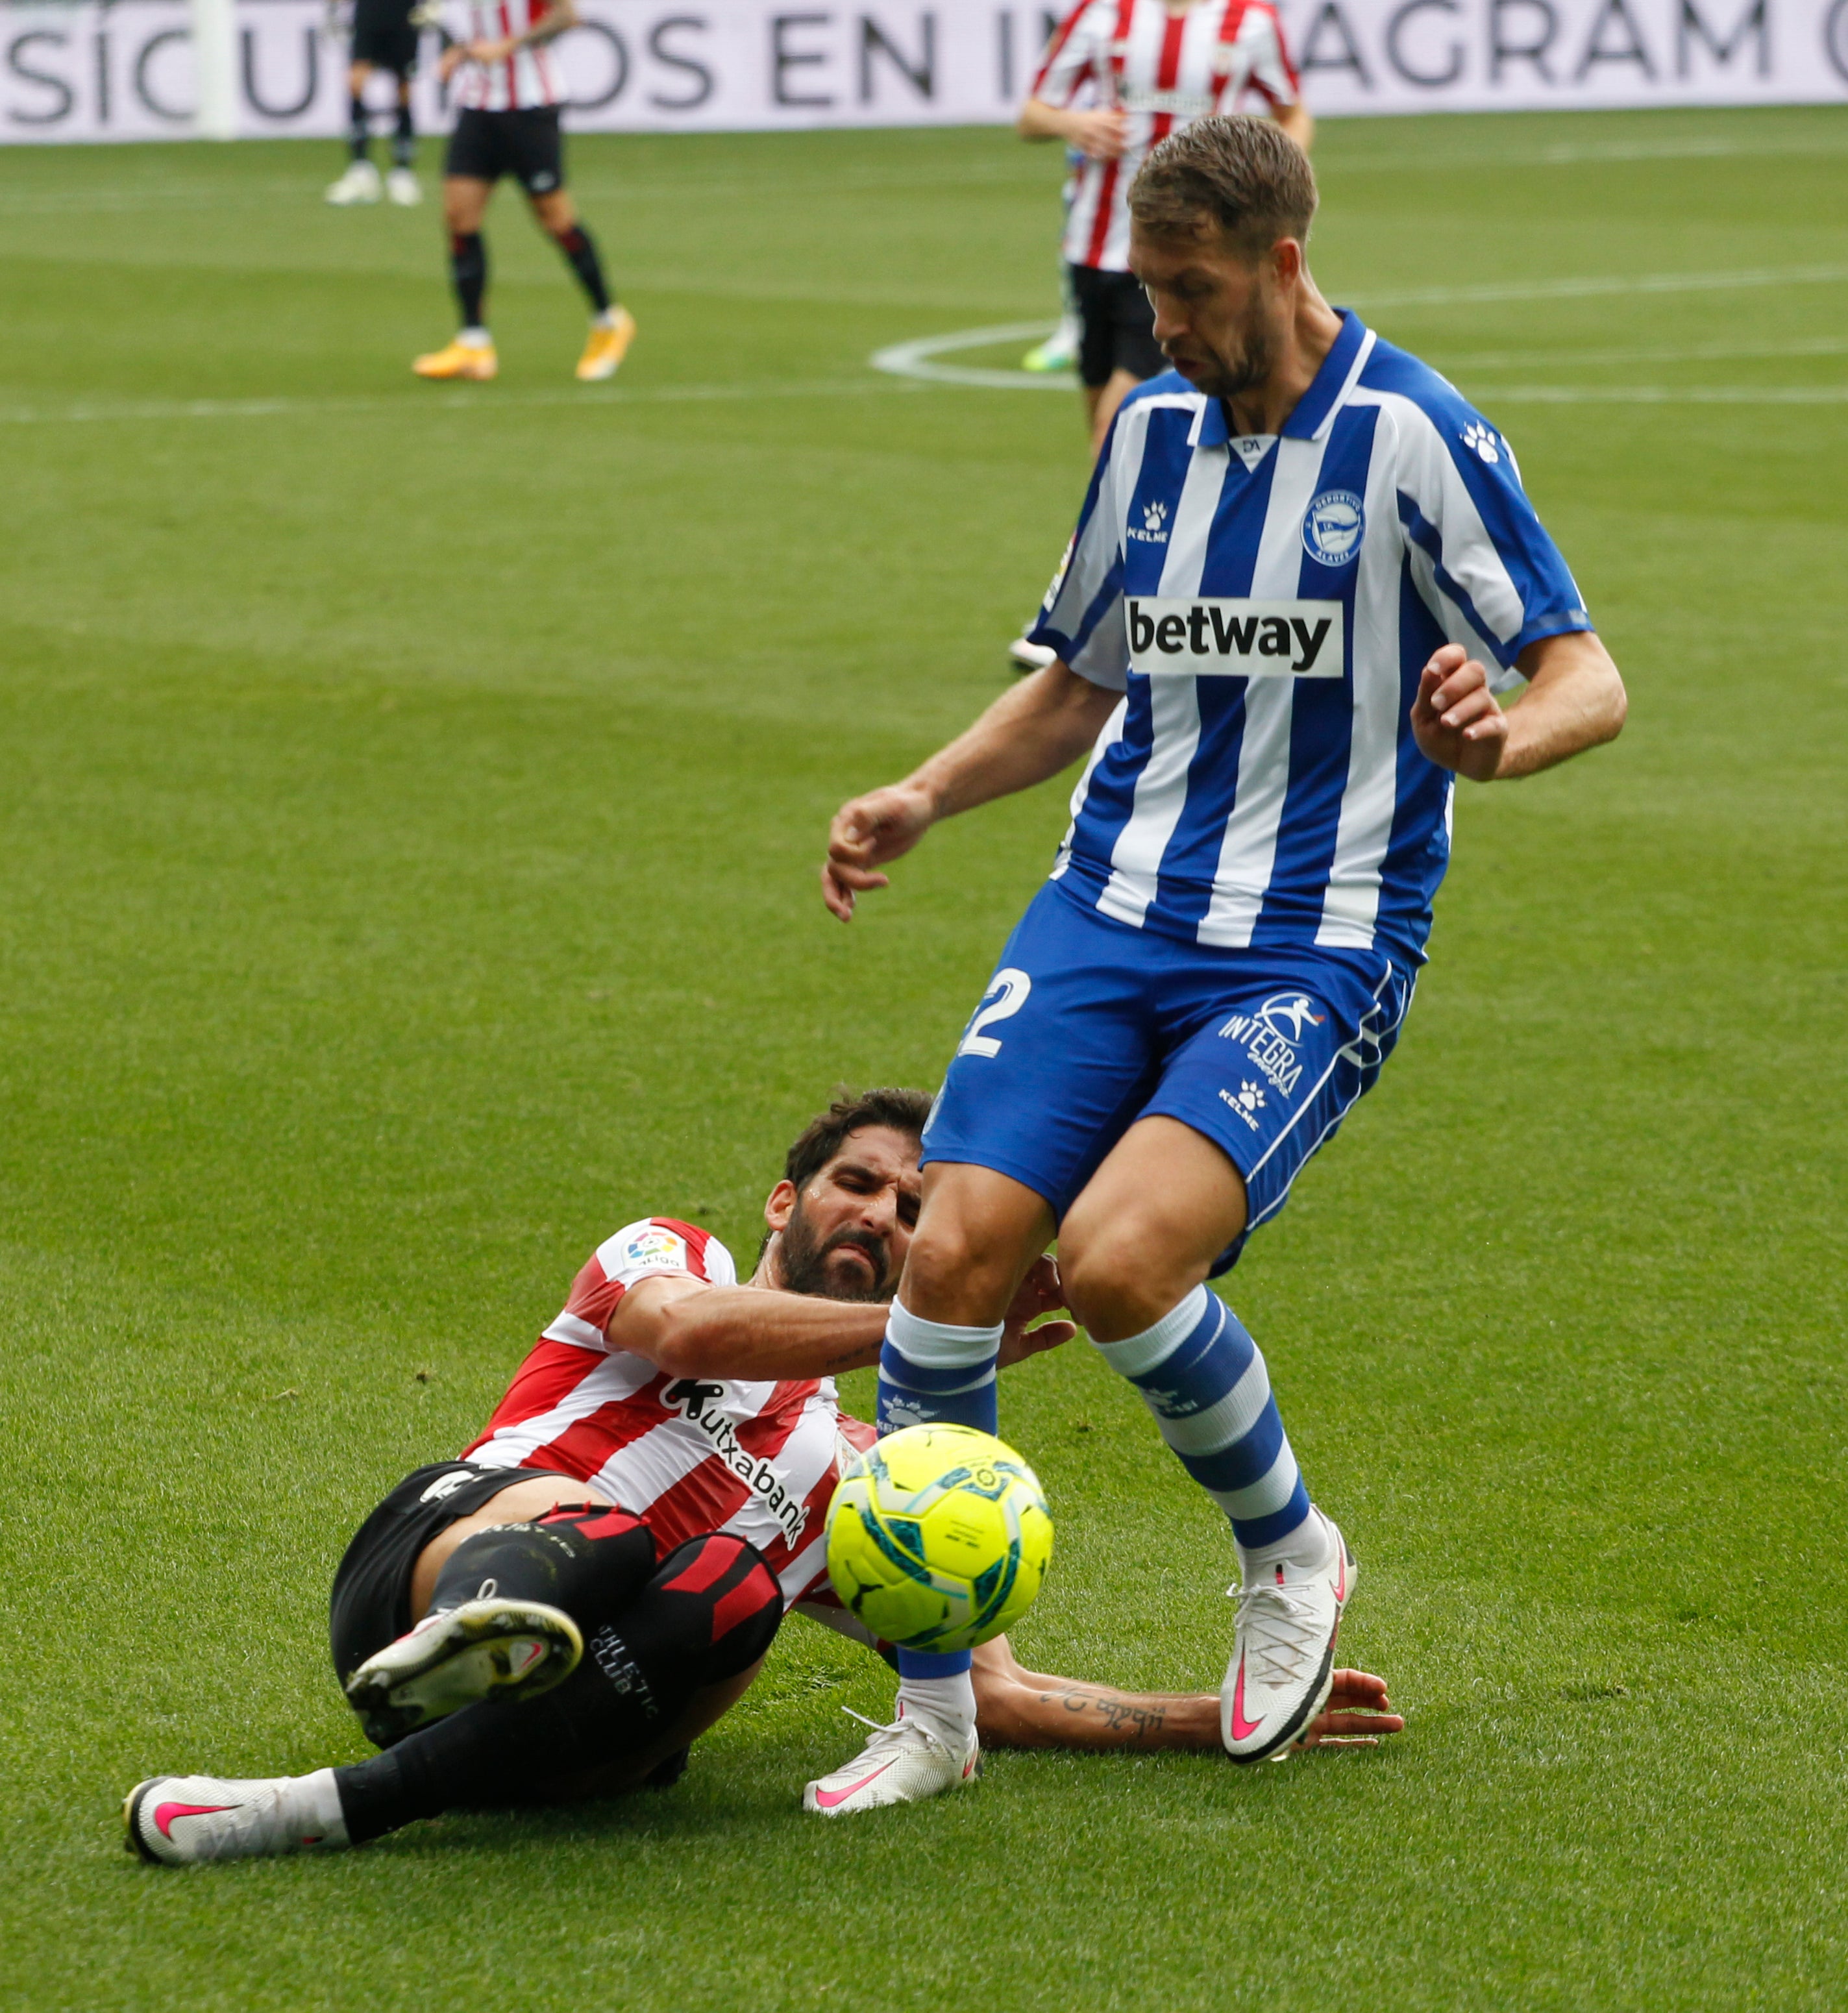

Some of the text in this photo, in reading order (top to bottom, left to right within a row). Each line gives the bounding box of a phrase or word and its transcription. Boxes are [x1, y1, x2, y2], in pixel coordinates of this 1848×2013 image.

[772, 12, 933, 107] EN
[1127, 526, 1168, 543] KELME
[1130, 602, 1331, 672] betway
[1218, 1015, 1303, 1094] INTEGRA
[1218, 1088, 1259, 1132] KELME
